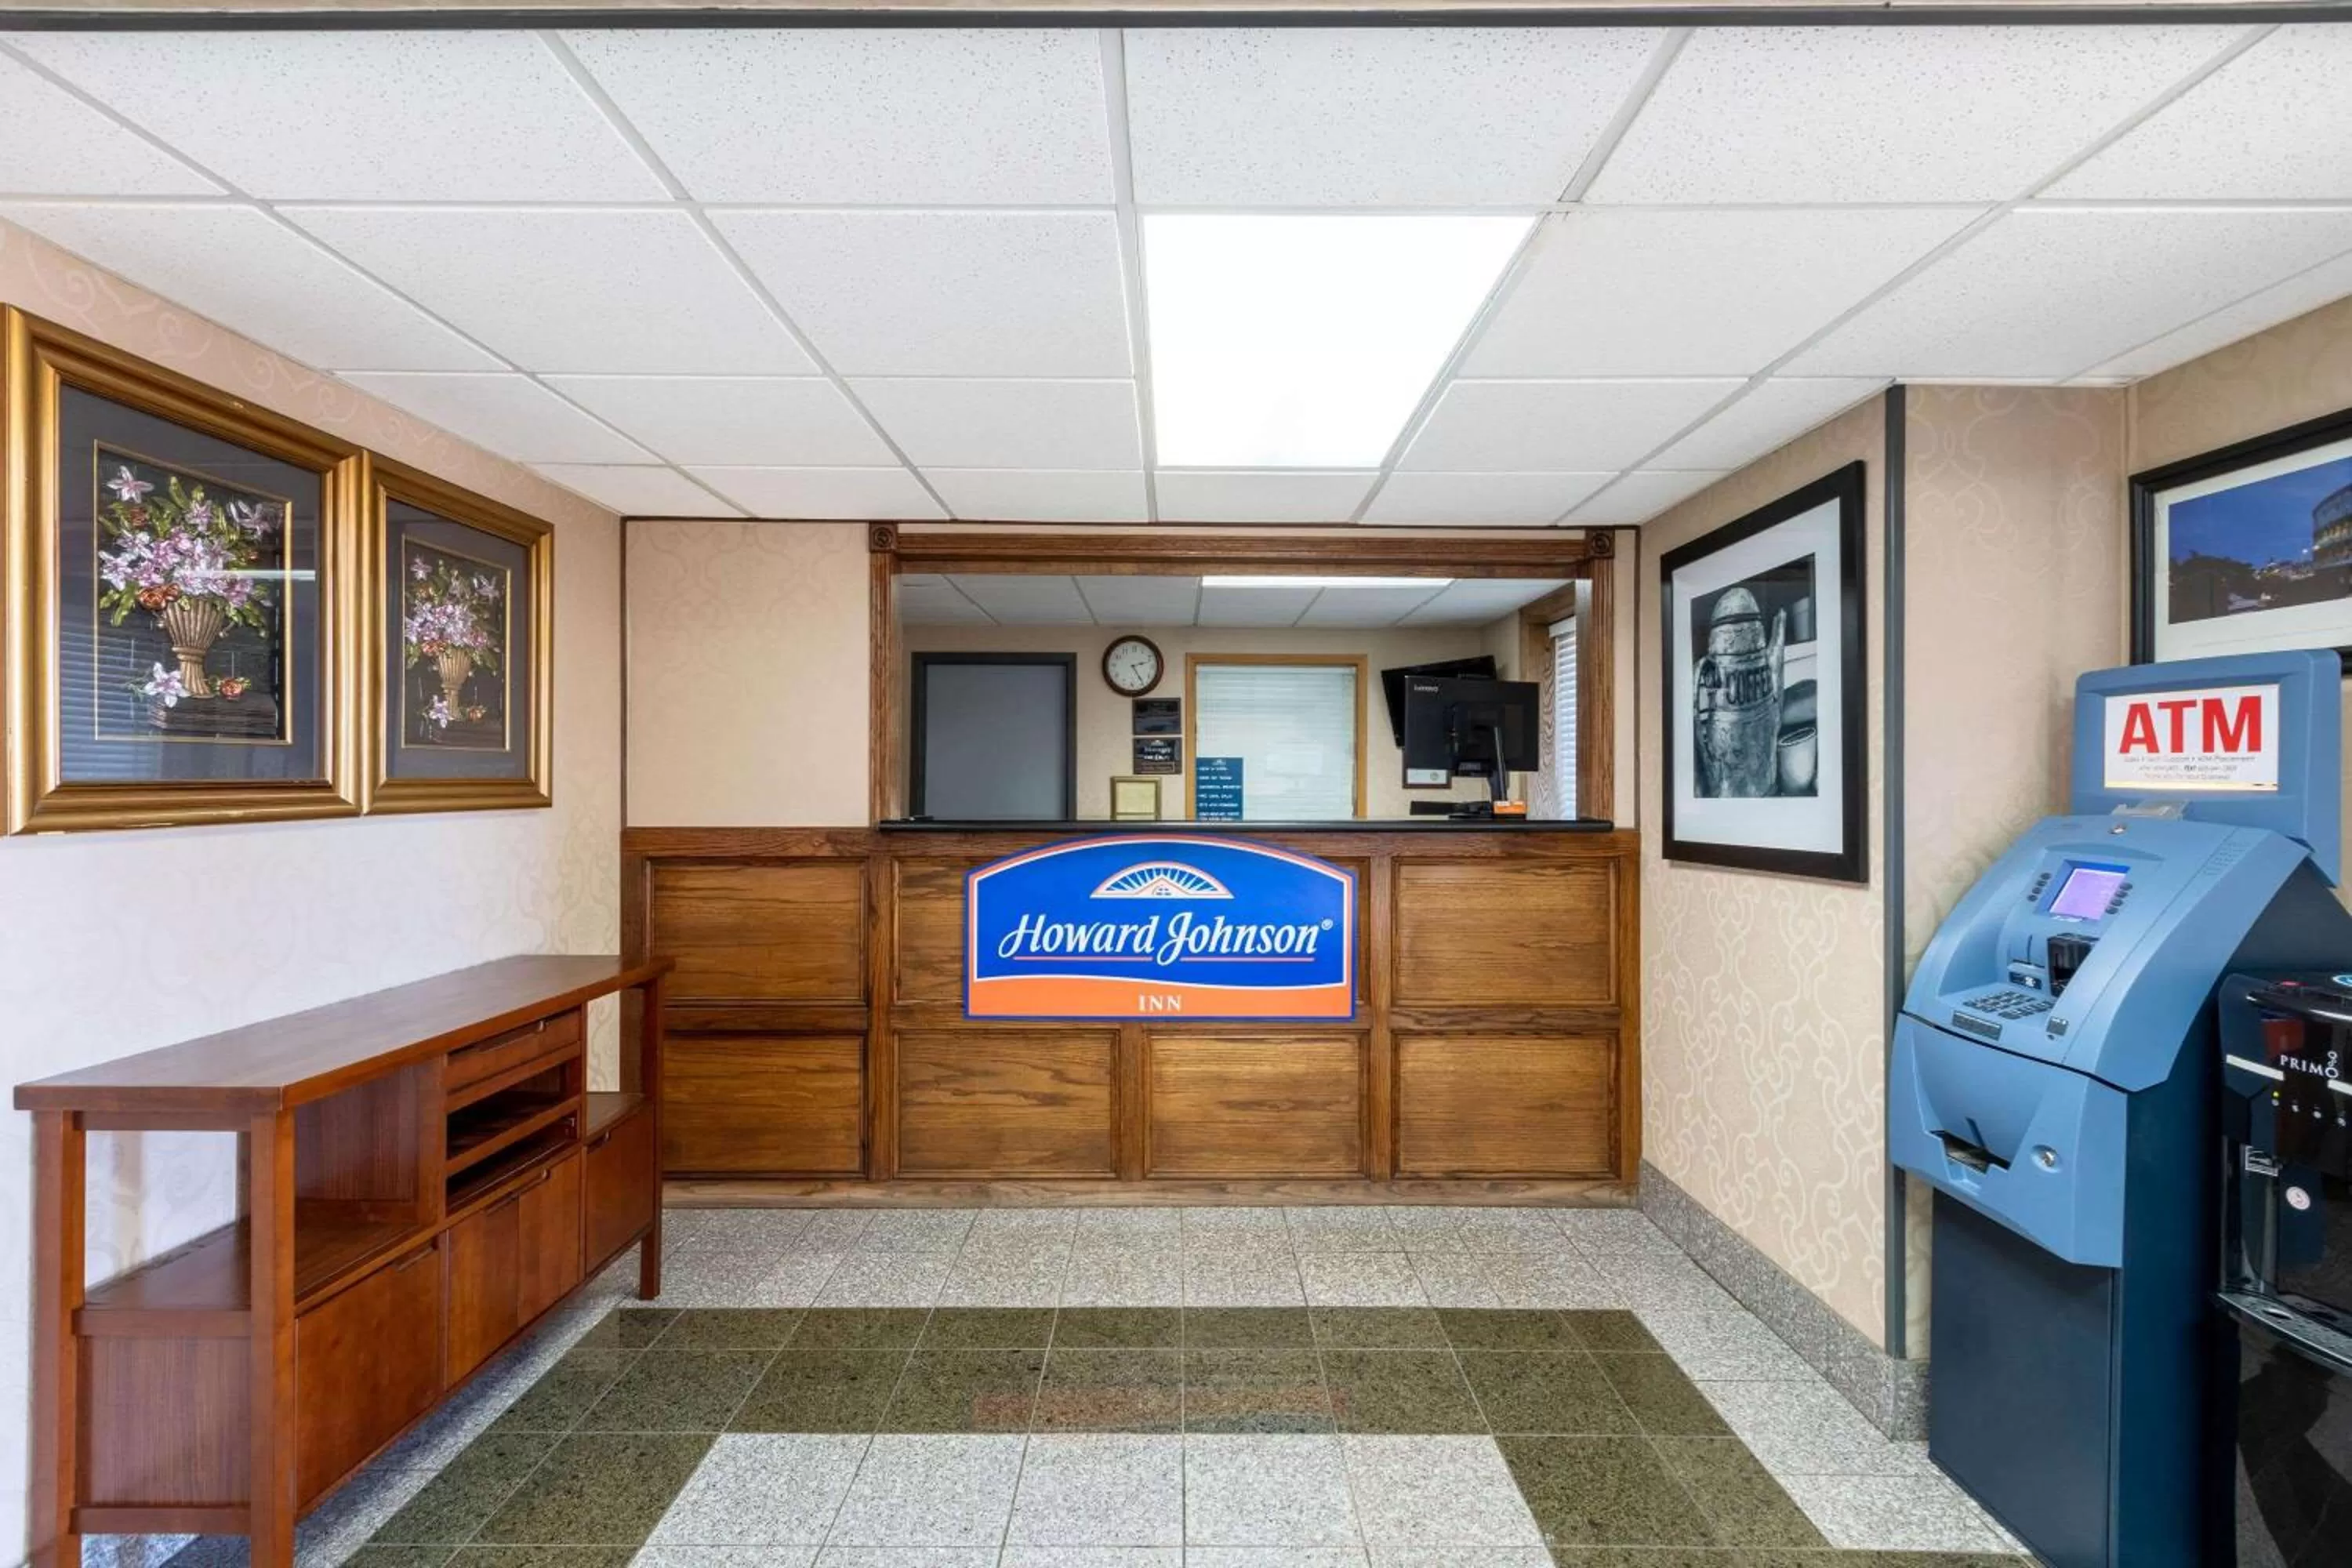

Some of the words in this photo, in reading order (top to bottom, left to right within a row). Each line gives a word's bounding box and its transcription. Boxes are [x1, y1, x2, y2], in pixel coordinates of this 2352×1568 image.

[2119, 695, 2262, 753] ATM
[998, 913, 1160, 958] Howard
[1138, 994, 1181, 1012] INN
[2280, 1054, 2339, 1078] PRIMO
